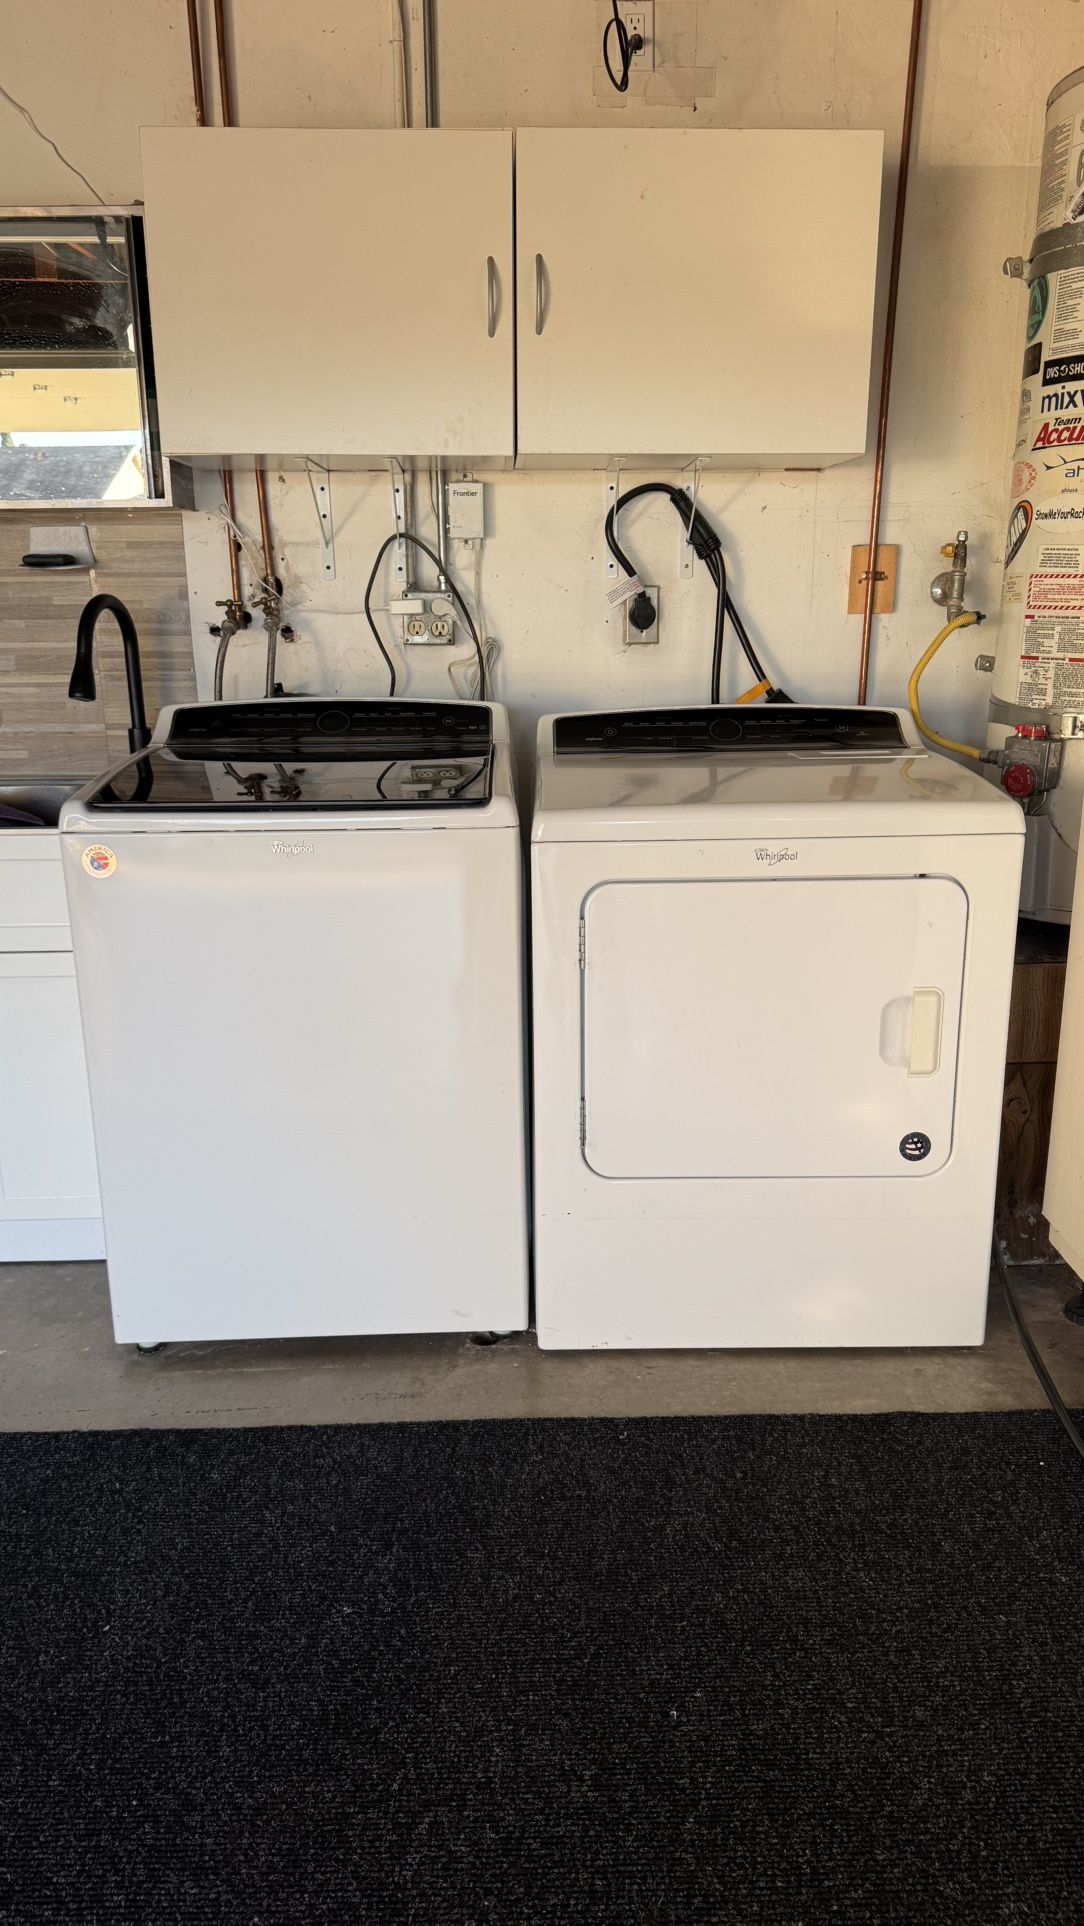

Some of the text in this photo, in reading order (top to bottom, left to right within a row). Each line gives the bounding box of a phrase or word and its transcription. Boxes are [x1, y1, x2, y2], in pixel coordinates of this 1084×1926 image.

[1053, 417, 1082, 427] Team
[271, 844, 314, 855] Whirlpool
[755, 851, 798, 863] Whirlpool
